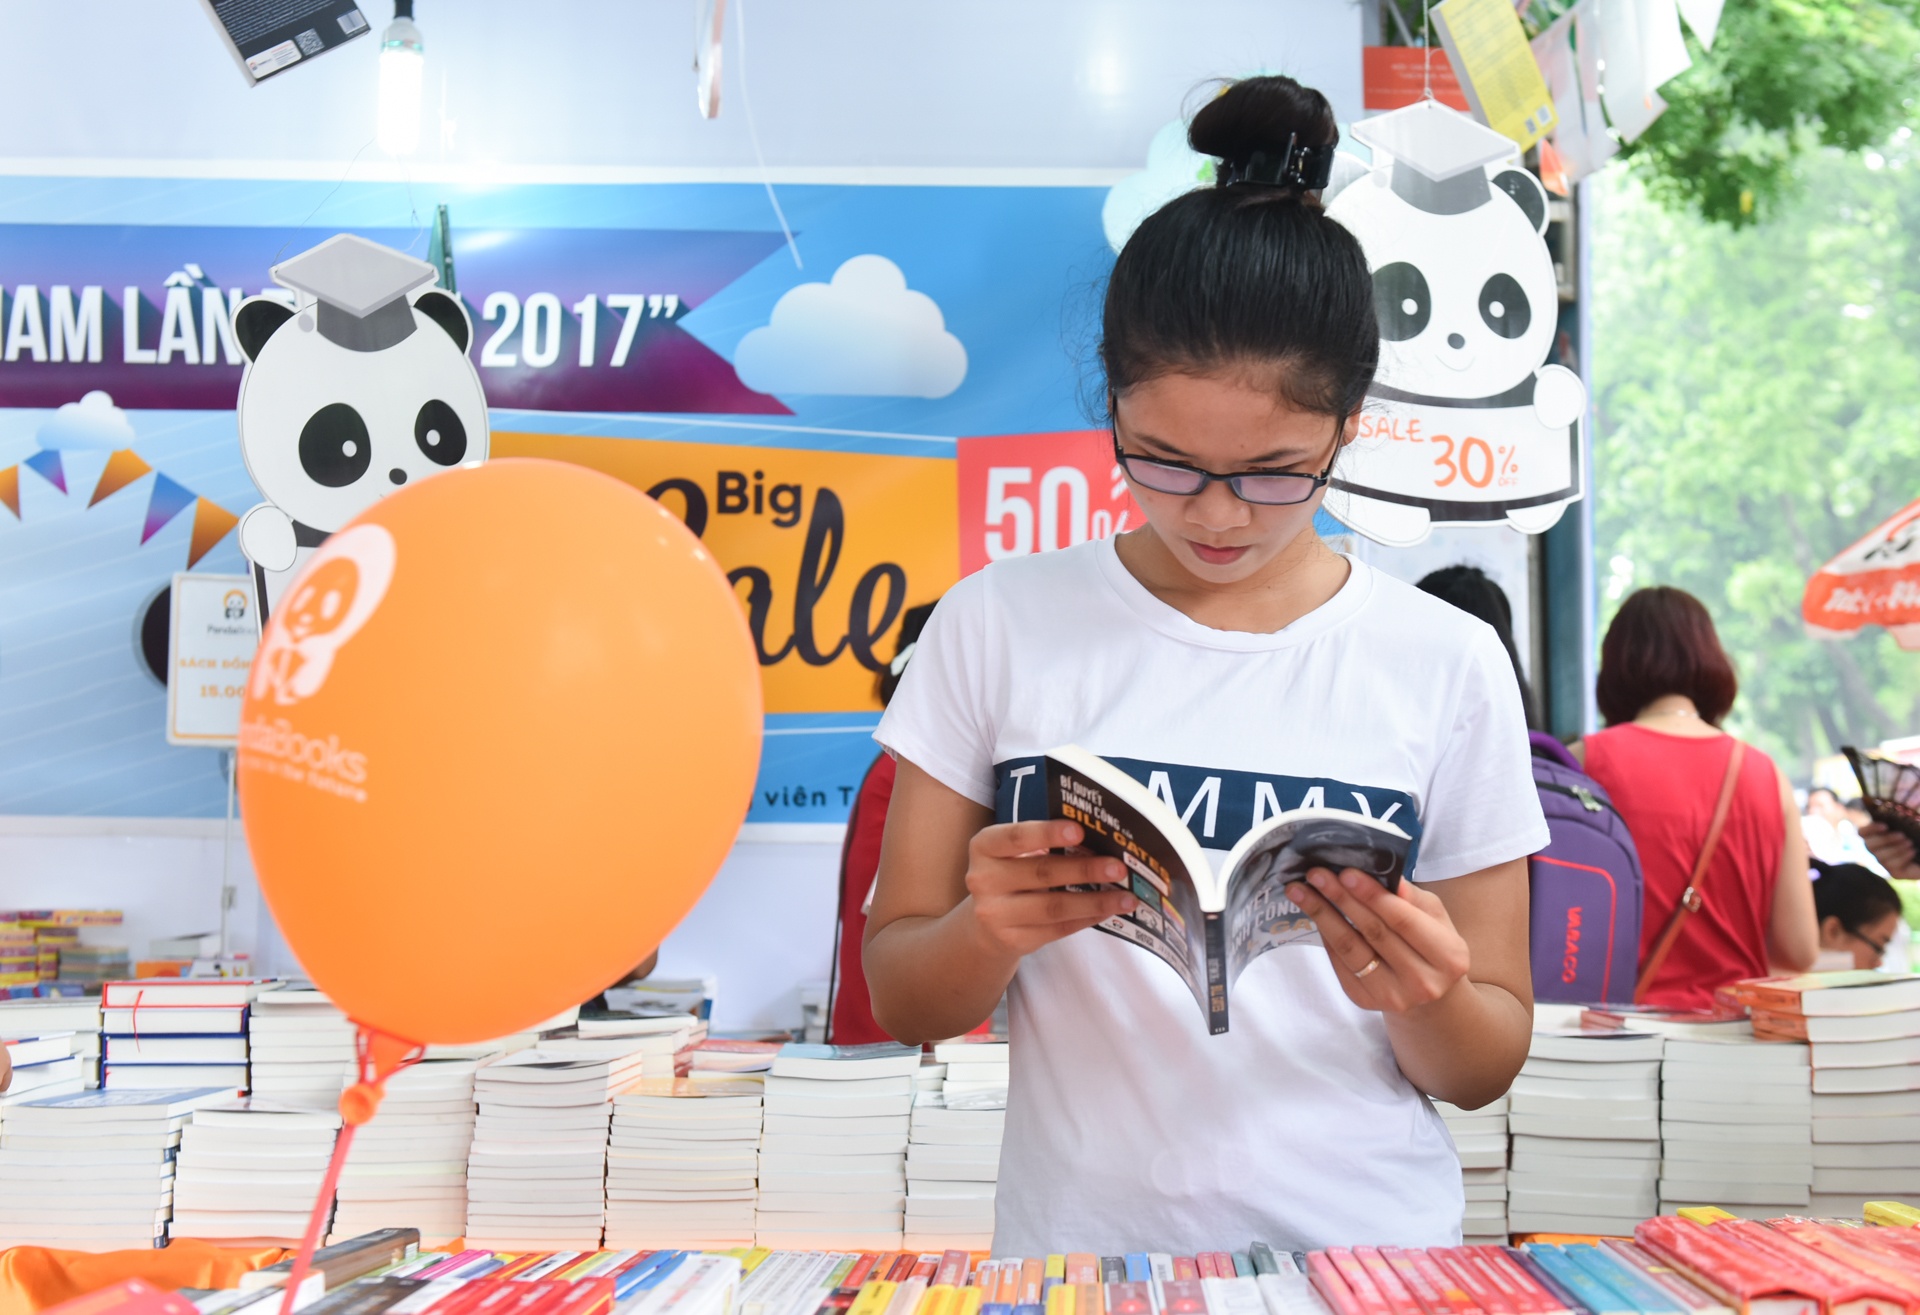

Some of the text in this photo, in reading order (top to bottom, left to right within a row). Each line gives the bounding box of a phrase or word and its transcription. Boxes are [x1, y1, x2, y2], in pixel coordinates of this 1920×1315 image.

[0, 285, 102, 362] AM
[123, 264, 243, 364] LẦN
[1360, 415, 1424, 443] SALE
[717, 470, 803, 528] Big
[764, 785, 827, 807] viên
[1009, 764, 1402, 838] TMMY
[1059, 774, 1072, 790] BÍ
[1062, 803, 1107, 836] BILL
[1113, 830, 1171, 886] GATES
